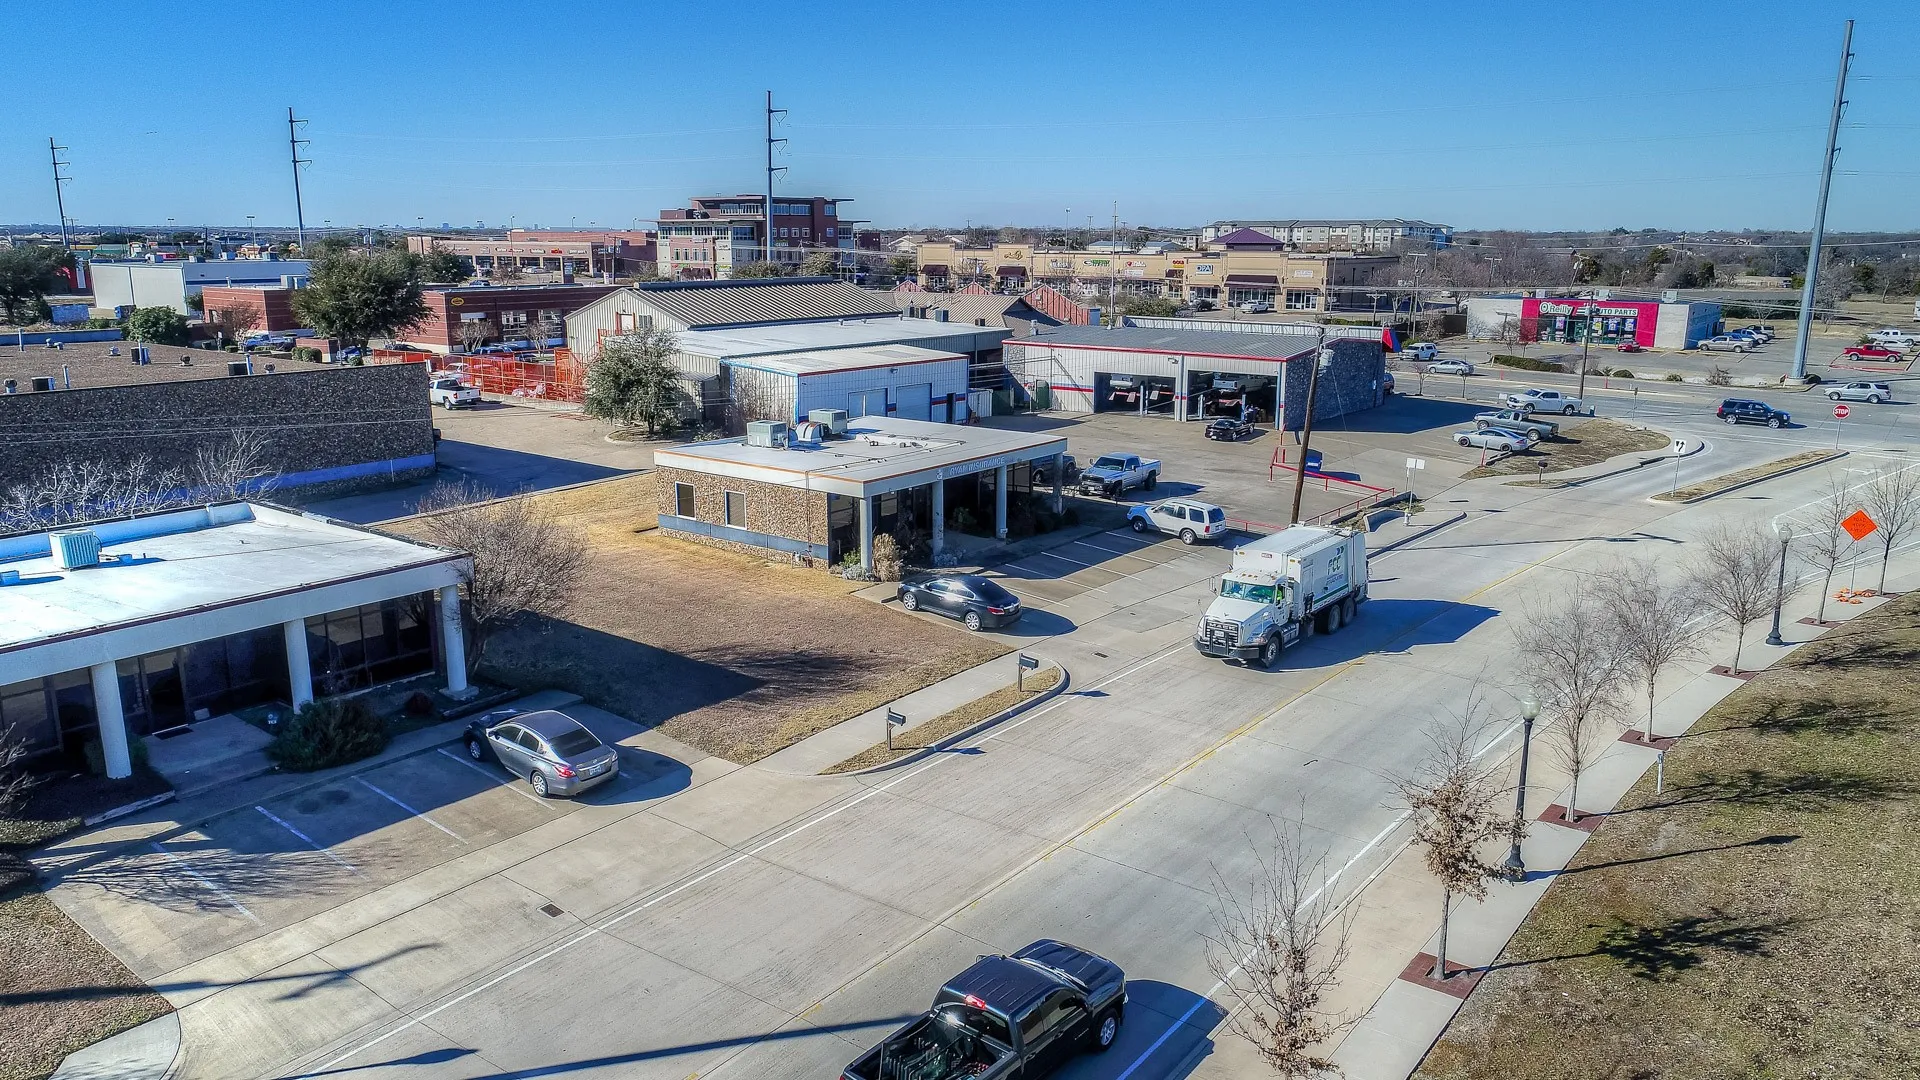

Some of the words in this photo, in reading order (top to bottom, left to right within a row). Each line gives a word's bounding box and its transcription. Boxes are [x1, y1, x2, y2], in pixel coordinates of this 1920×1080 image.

[1540, 302, 1572, 315] O'Reilly
[949, 466, 967, 476] RYAN
[968, 456, 1005, 472] INSURANCE
[1209, 622, 1237, 632] MACK
